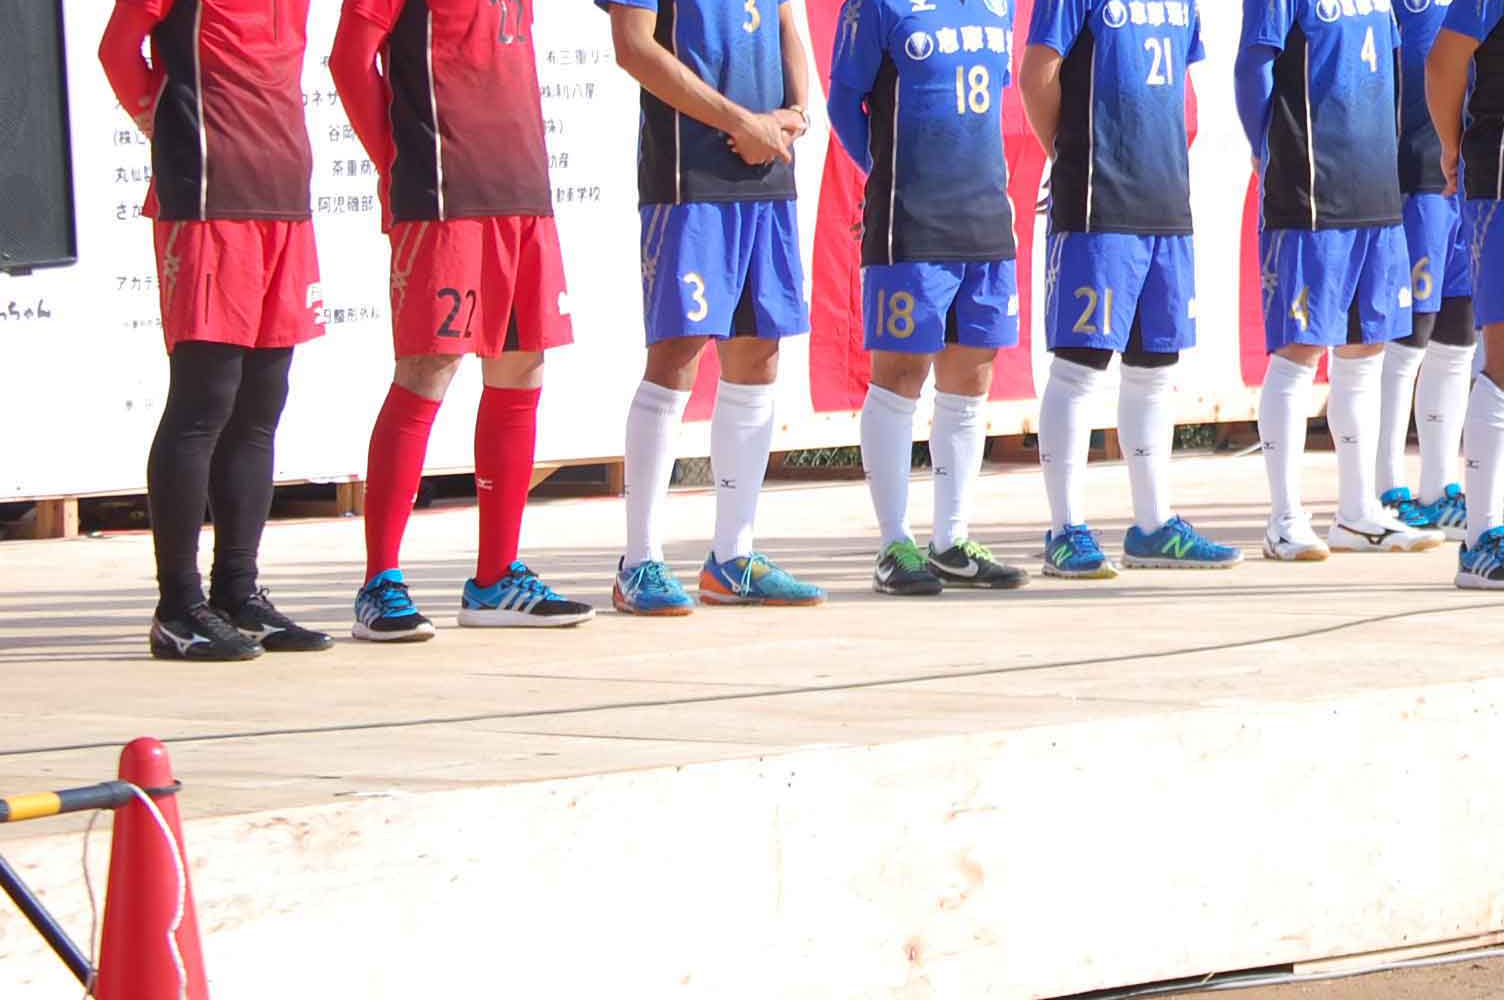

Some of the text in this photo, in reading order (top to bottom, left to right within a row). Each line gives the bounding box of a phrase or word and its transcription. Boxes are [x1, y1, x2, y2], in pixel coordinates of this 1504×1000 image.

[1143, 36, 1174, 86] 21
[1360, 25, 1378, 73] 4
[955, 64, 991, 116] 18
[681, 271, 708, 323] 3
[1412, 256, 1433, 300] 6
[436, 287, 477, 339] 22
[876, 289, 917, 339] 18
[1072, 286, 1114, 335] 21
